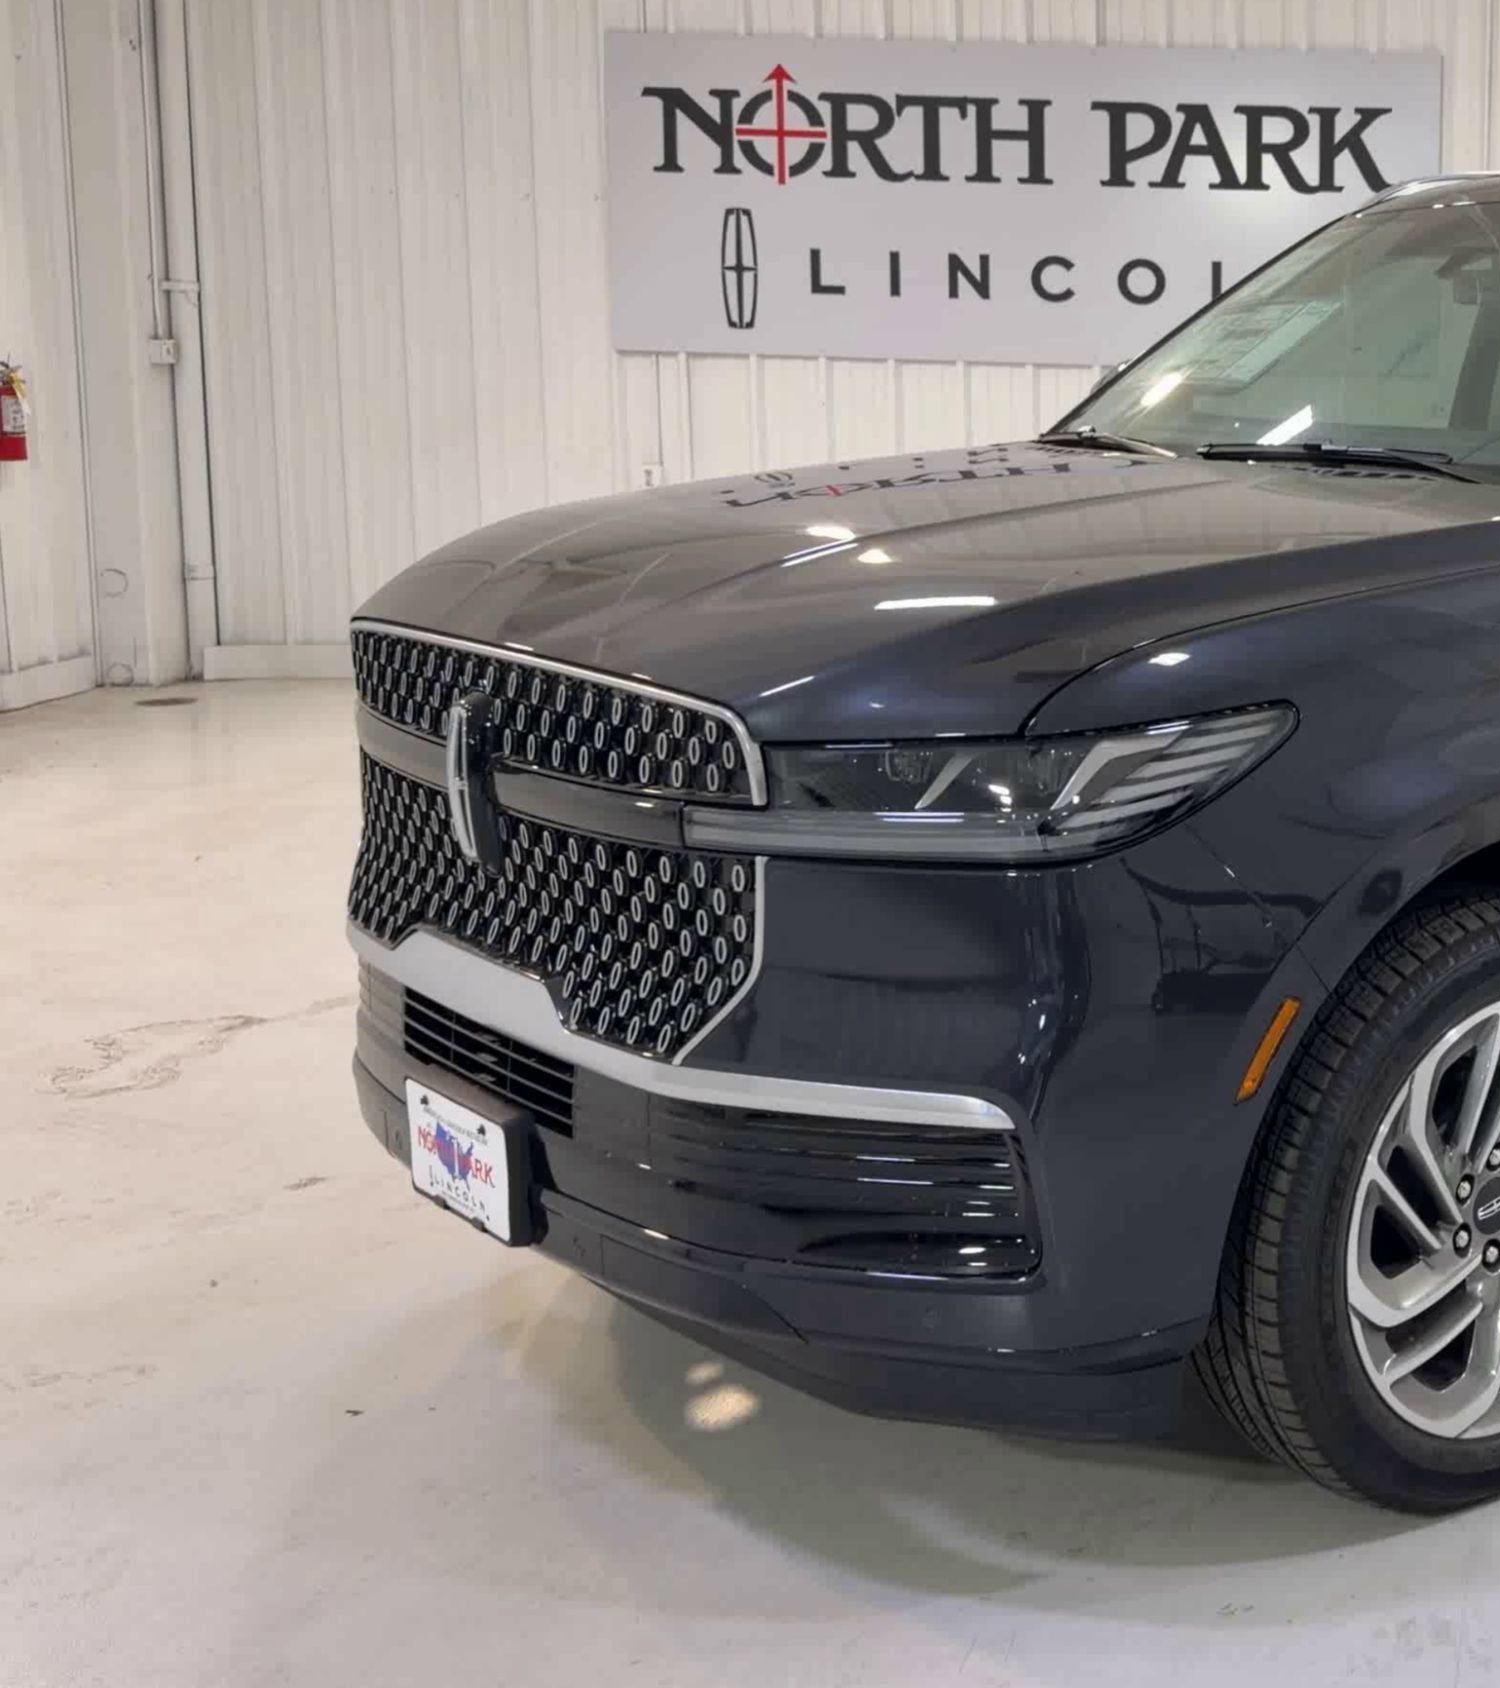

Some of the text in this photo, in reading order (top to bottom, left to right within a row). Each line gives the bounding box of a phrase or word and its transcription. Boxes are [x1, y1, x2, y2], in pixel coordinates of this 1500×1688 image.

[642, 84, 1392, 194] NORTH PARK
[811, 249, 1221, 304] LINCOL
